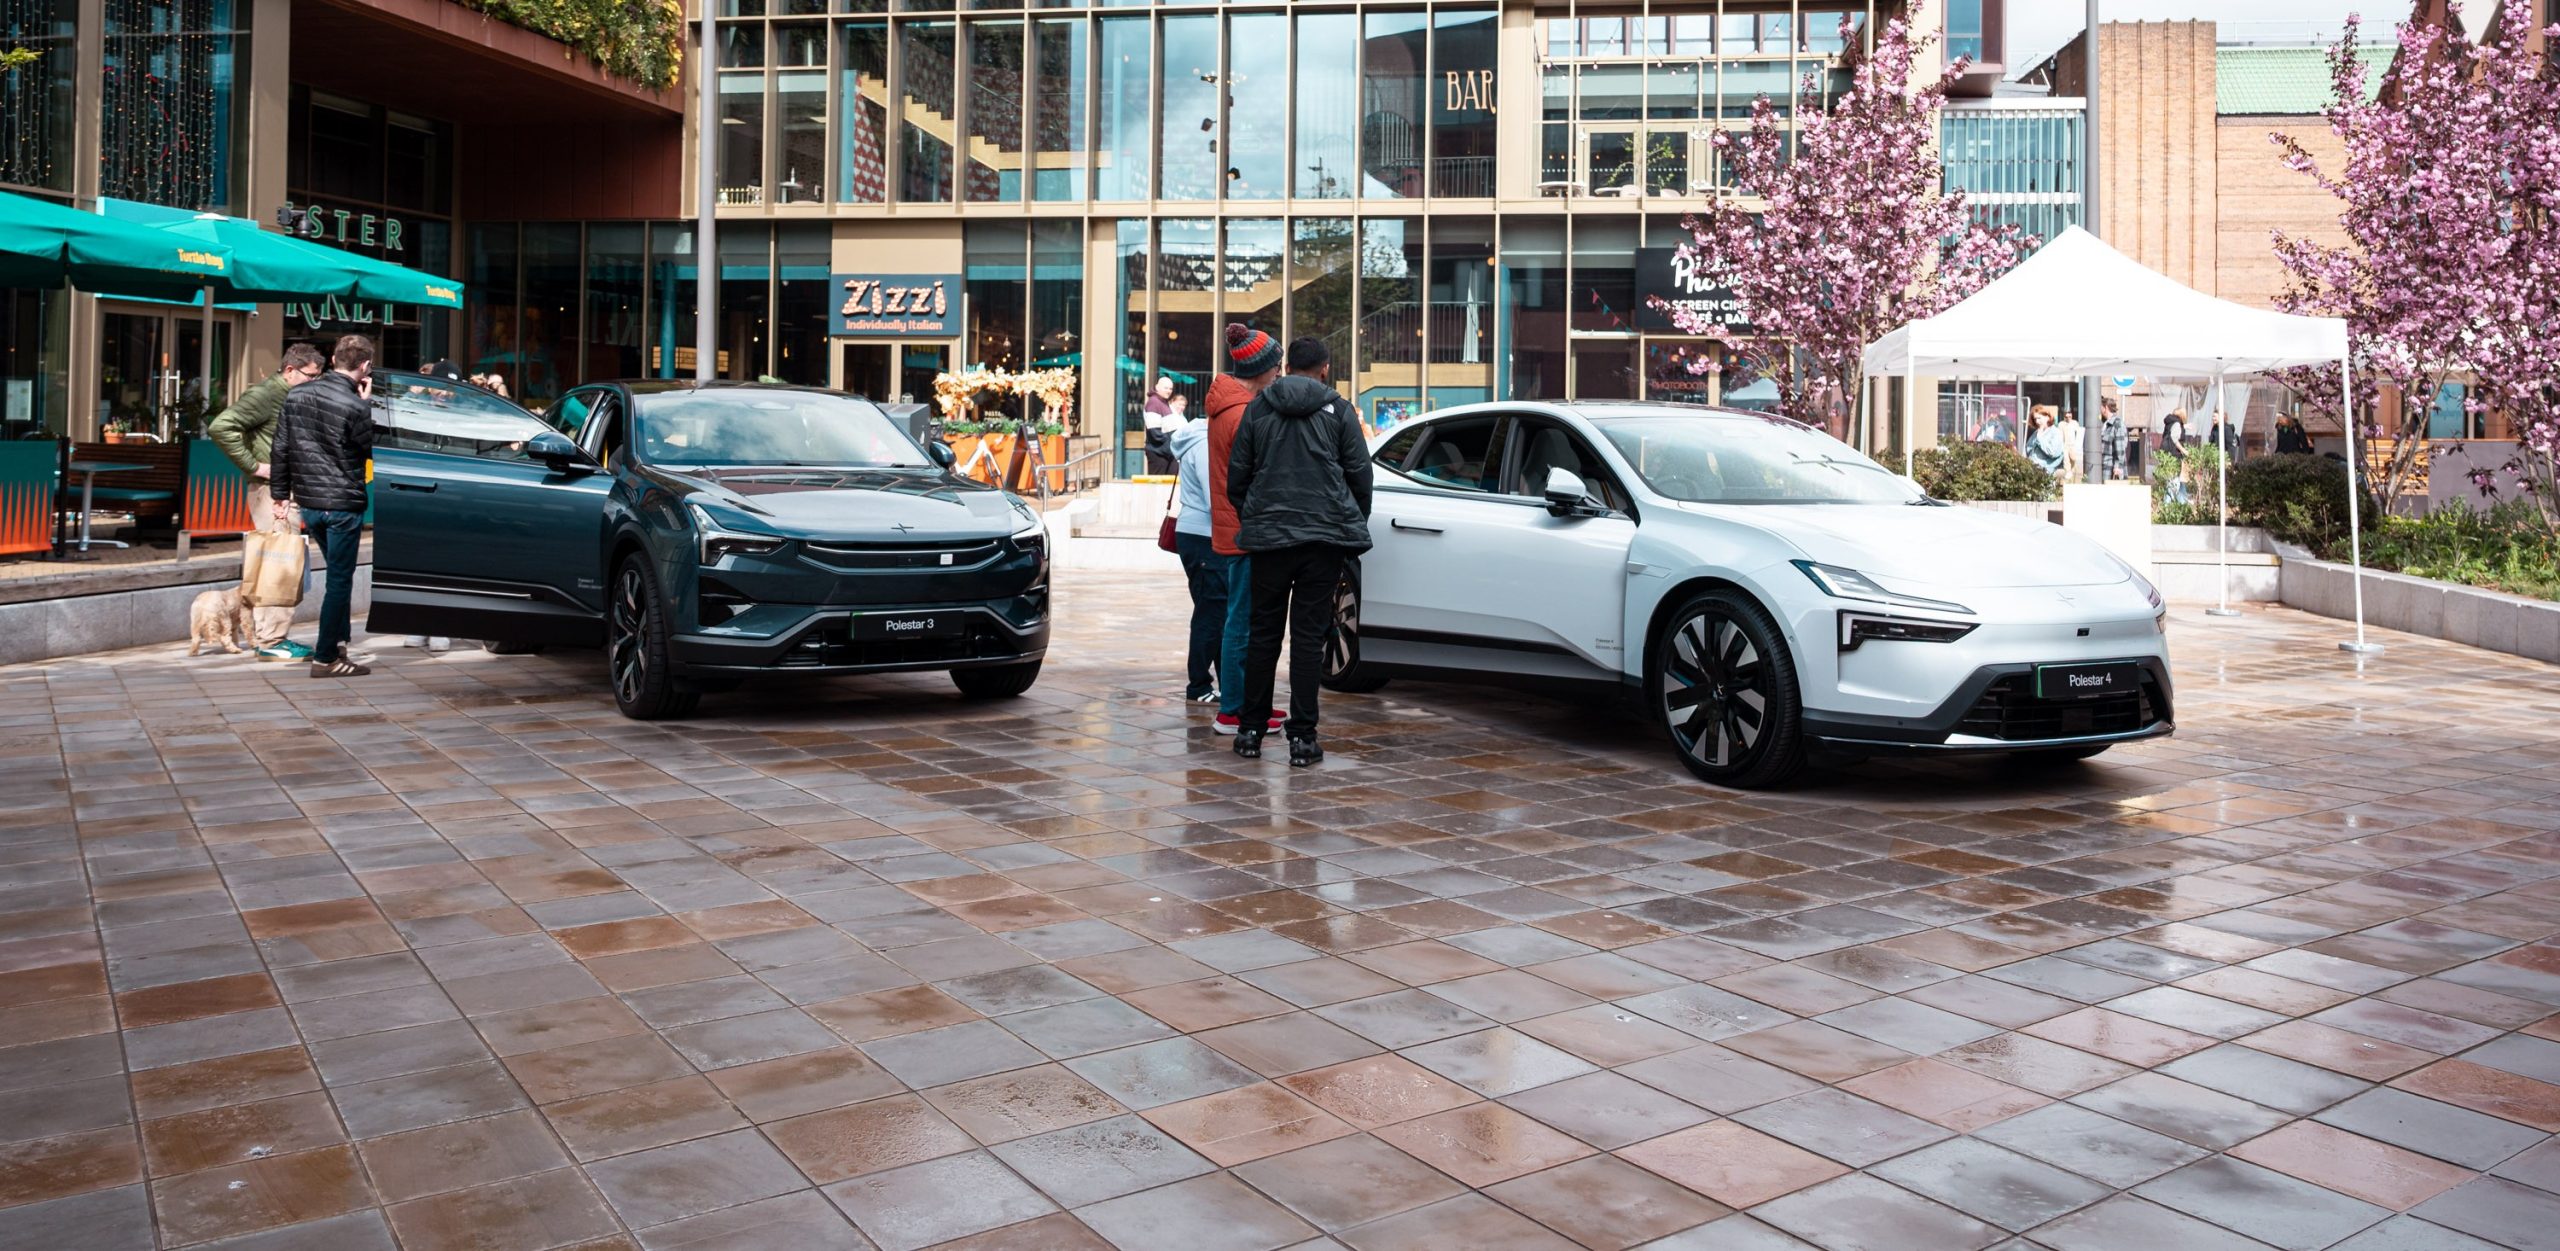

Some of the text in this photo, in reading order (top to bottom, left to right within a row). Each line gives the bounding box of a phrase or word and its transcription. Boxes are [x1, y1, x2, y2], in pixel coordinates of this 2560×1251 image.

[1446, 70, 1497, 114] BAR
[842, 280, 946, 316] Zizzi
[846, 319, 943, 332] Individually Italian
[1725, 313, 1749, 324] BAR
[886, 618, 934, 631] Polestar 3
[2069, 672, 2112, 687] Polestar 4
